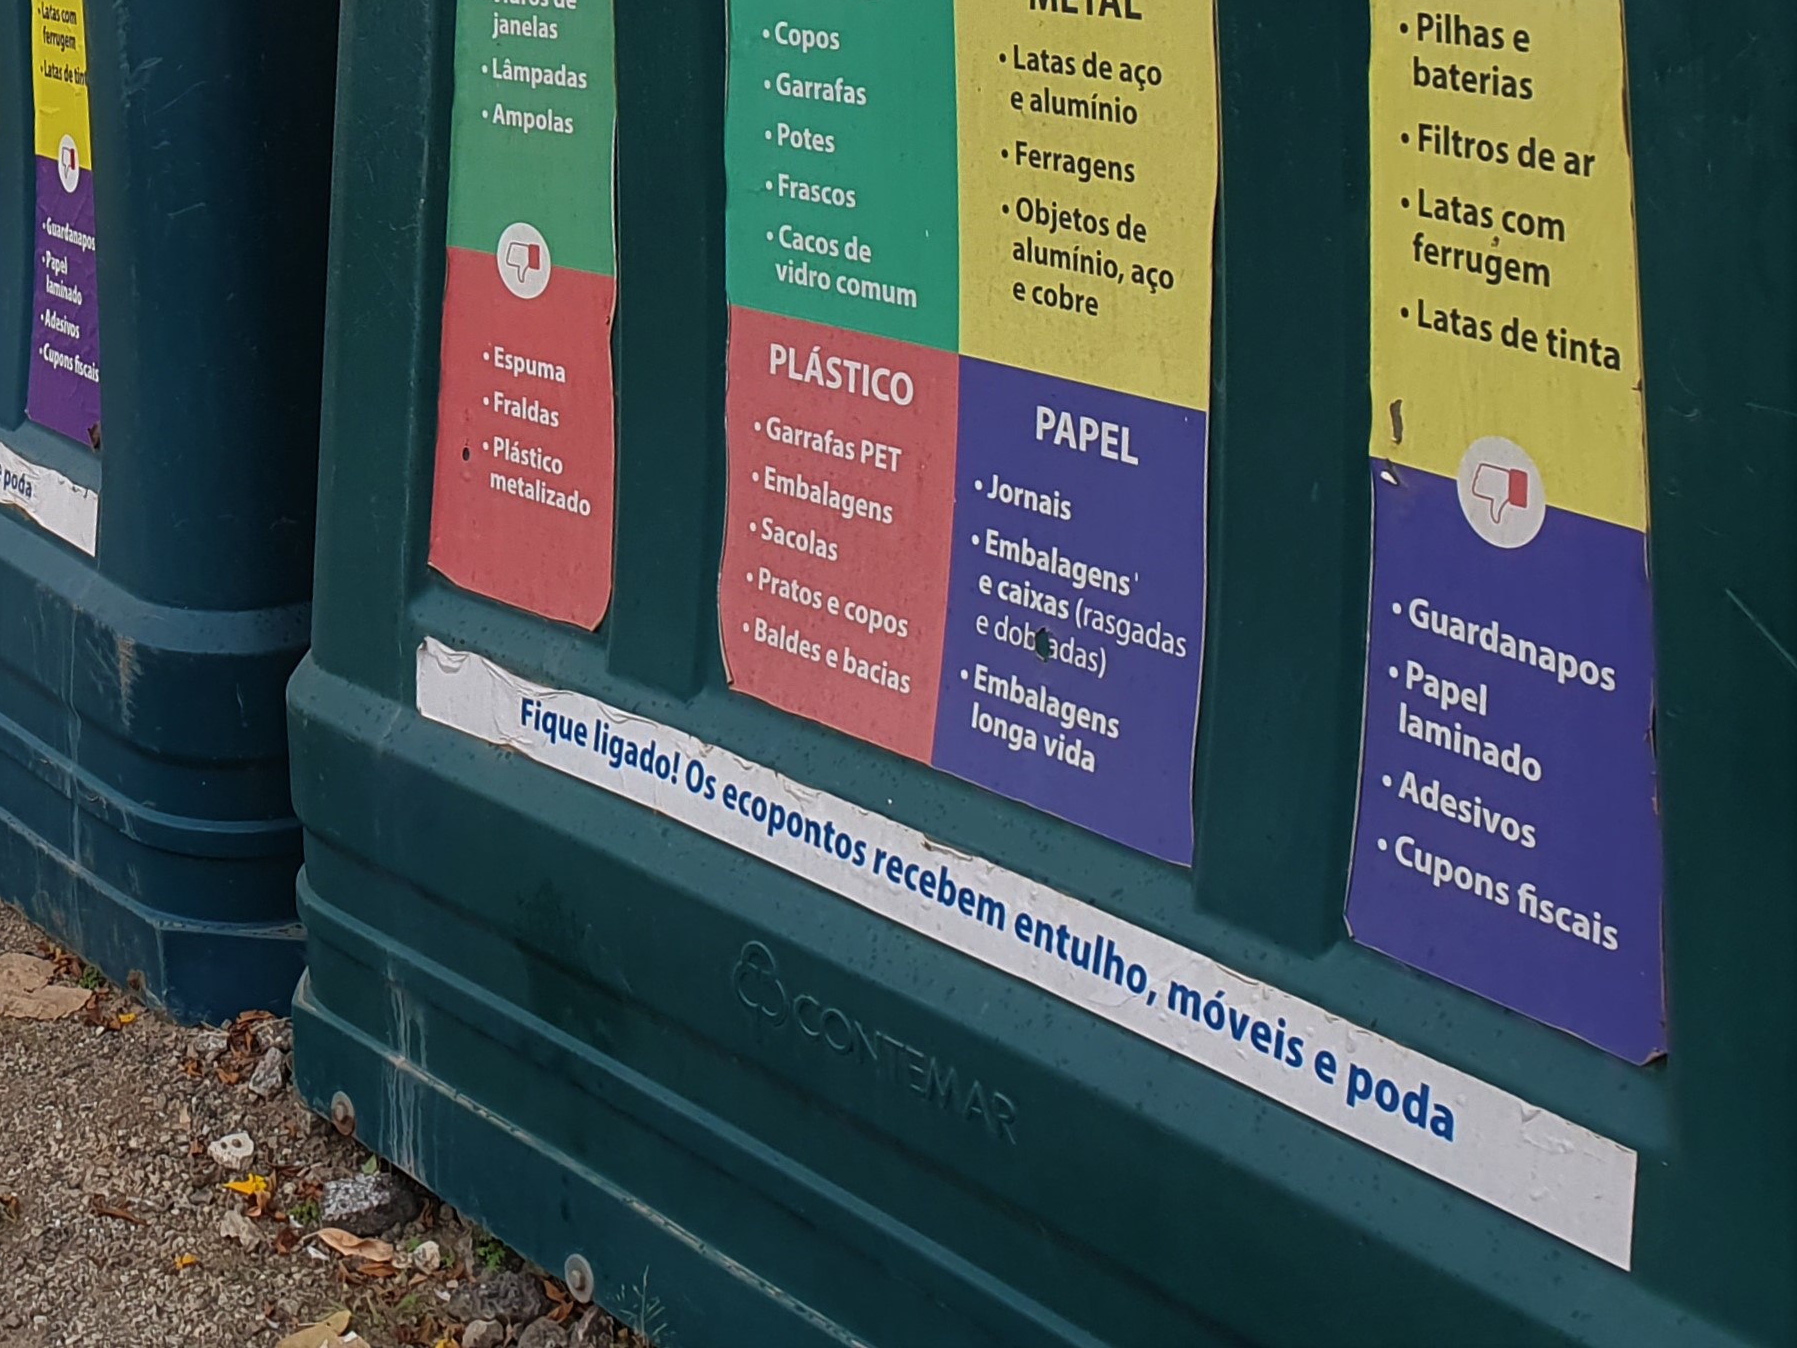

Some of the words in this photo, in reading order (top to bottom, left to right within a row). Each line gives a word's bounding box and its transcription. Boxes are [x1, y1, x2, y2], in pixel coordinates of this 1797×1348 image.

[492, 12, 559, 40] janelas
[774, 21, 841, 54] Copos
[1416, 12, 1505, 50] Pilhas
[1513, 26, 1531, 52] e
[492, 58, 588, 90] Lâmpadas
[776, 72, 867, 106] Garrafas
[1013, 44, 1076, 76] Latas
[1082, 54, 1113, 81] de
[1119, 63, 1163, 92] aço
[1413, 56, 1534, 100] baterias
[492, 103, 574, 134] Ampolas
[1010, 92, 1023, 111] e
[1029, 88, 1138, 125] alumínio
[776, 123, 836, 154] Potes
[1014, 140, 1136, 184] Ferragens
[1417, 123, 1509, 165] Filtros
[1517, 137, 1555, 171] de
[1563, 150, 1595, 178] ar
[777, 174, 857, 209] Frascos
[1417, 188, 1493, 229] Latas
[1501, 206, 1566, 243] com
[778, 224, 840, 257] Cacos
[844, 236, 872, 264] de
[1015, 197, 1110, 237] Objetos
[1115, 212, 1148, 243] de
[775, 259, 831, 291] vidro
[836, 272, 918, 308] comum
[1012, 238, 1125, 283] alumínio,
[1131, 265, 1175, 295] aço
[1413, 233, 1552, 287] ferrugem
[1012, 281, 1026, 301] e
[1032, 280, 1099, 316] cobre
[1417, 299, 1493, 340] Latas
[1500, 316, 1538, 352] de
[1545, 328, 1622, 371] tinta
[494, 346, 566, 384] Espuma
[769, 343, 914, 406] PLÁSTICO
[494, 391, 560, 428] Fraldas
[493, 437, 564, 476] Plástico
[1036, 405, 1139, 466] PAPEL
[4, 465, 32, 498] poda
[490, 470, 591, 517] metalizado
[987, 473, 1073, 521] Jornais
[985, 529, 1131, 596] Embalagens
[979, 575, 993, 595] e
[997, 580, 1070, 621] caixas
[1074, 596, 1188, 660] (rasgadas
[975, 614, 988, 634] e
[994, 615, 1107, 678] dobadas)
[1408, 598, 1616, 692] Guardanapos
[973, 664, 1120, 738] Embalagens
[1406, 660, 1488, 716] Papel
[971, 702, 1037, 751] longa
[1043, 727, 1096, 773] vida
[1399, 704, 1543, 782] laminado
[1398, 770, 1538, 850] Adesivos
[1395, 836, 1510, 906] Cupons
[1518, 884, 1619, 950] fiscais
[520, 698, 588, 749] Fique
[593, 723, 681, 787] ligado!
[685, 759, 716, 800] Os
[721, 781, 867, 867] ecopontos
[872, 846, 1006, 932] recebem
[1013, 908, 1159, 1006] entulho,
[1166, 971, 1305, 1068] móveis
[1313, 1047, 1338, 1084] e
[1347, 1058, 1457, 1143] poda
[793, 993, 1021, 1144] CONTEMAR
